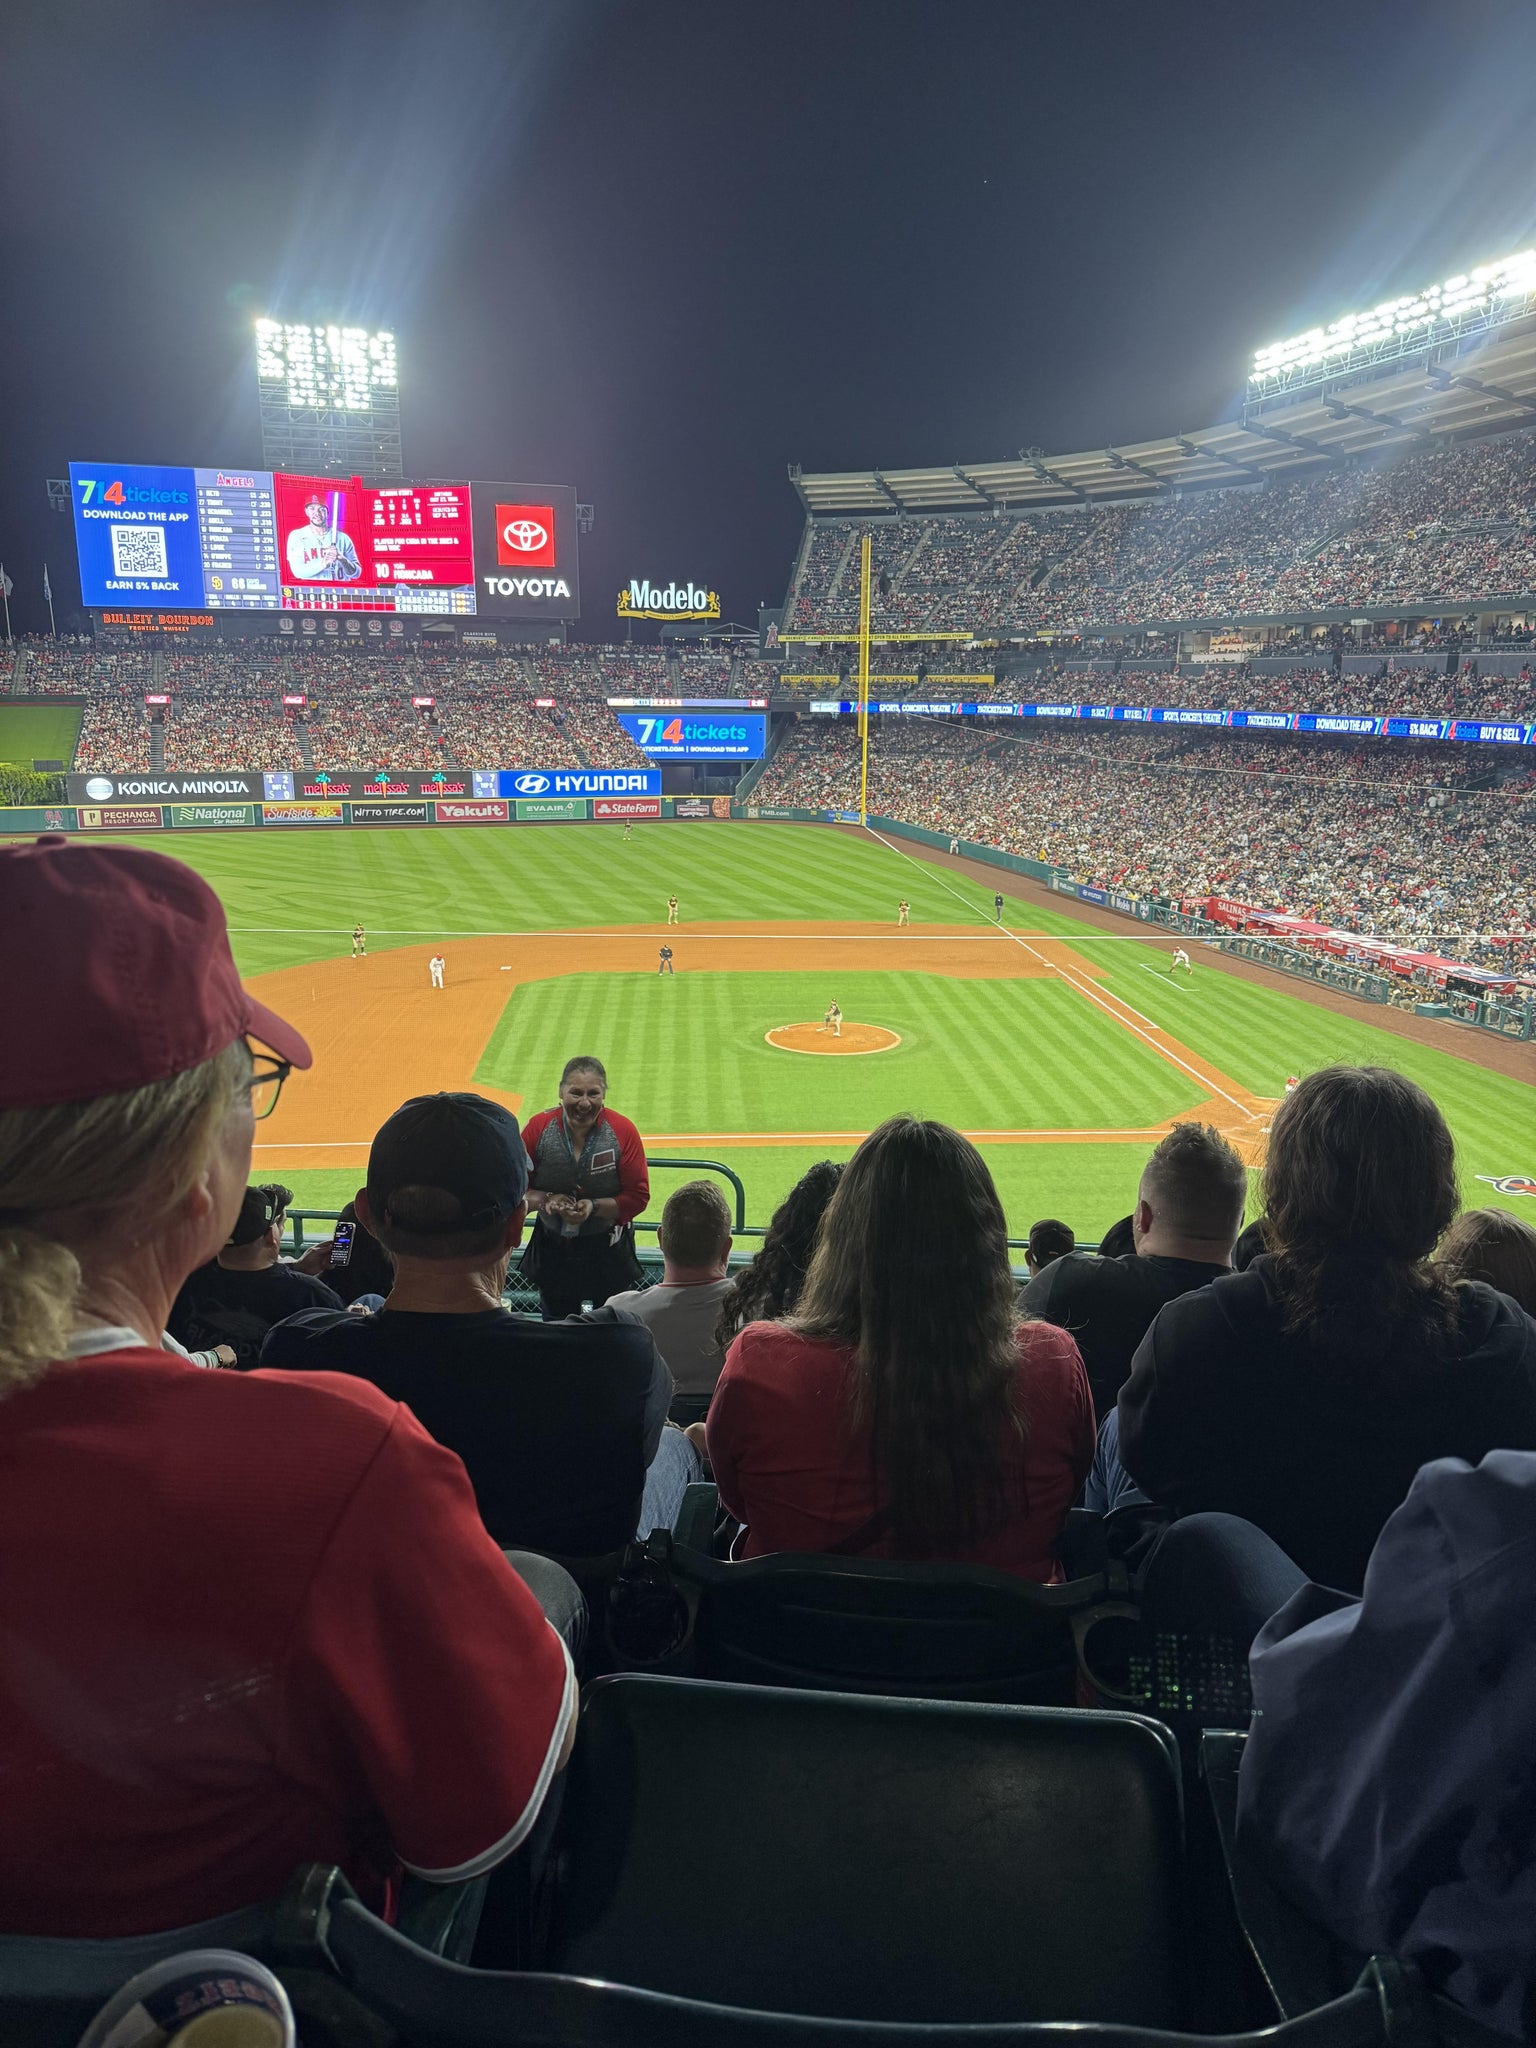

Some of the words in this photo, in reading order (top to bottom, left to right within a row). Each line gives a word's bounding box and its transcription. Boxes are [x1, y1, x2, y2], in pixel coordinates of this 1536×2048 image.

[83, 510, 146, 520] DOWNLOAD
[147, 512, 167, 521] THE
[168, 513, 189, 522] APP
[375, 563, 389, 578] 10
[106, 581, 133, 590] EARN
[135, 582, 149, 590] 5%
[151, 582, 179, 591] BACK
[484, 577, 571, 597] TOYOTA
[630, 580, 707, 610] Modelo
[103, 613, 153, 624] BULLEIT
[158, 614, 214, 625] BOURBON
[1316, 718, 1348, 730] DOWNLOAD
[1349, 720, 1360, 730] THE
[1360, 720, 1373, 732] APP
[1409, 723, 1419, 735] 5%
[1420, 723, 1438, 736] BACK
[1480, 726, 1495, 739] BUY
[1496, 728, 1502, 740] &
[1503, 728, 1520, 741] SELL
[118, 782, 180, 795] KONICA
[182, 781, 249, 794] MINOLTA
[556, 775, 648, 792] HYUNDAI
[104, 811, 156, 819] PECHANGA
[195, 808, 246, 819] National
[268, 806, 313, 819] Surfside
[354, 809, 381, 817] NITTO
[384, 808, 424, 817] TIRE.COM
[441, 805, 504, 817] Yakult
[1217, 901, 1246, 916] SALINAS
